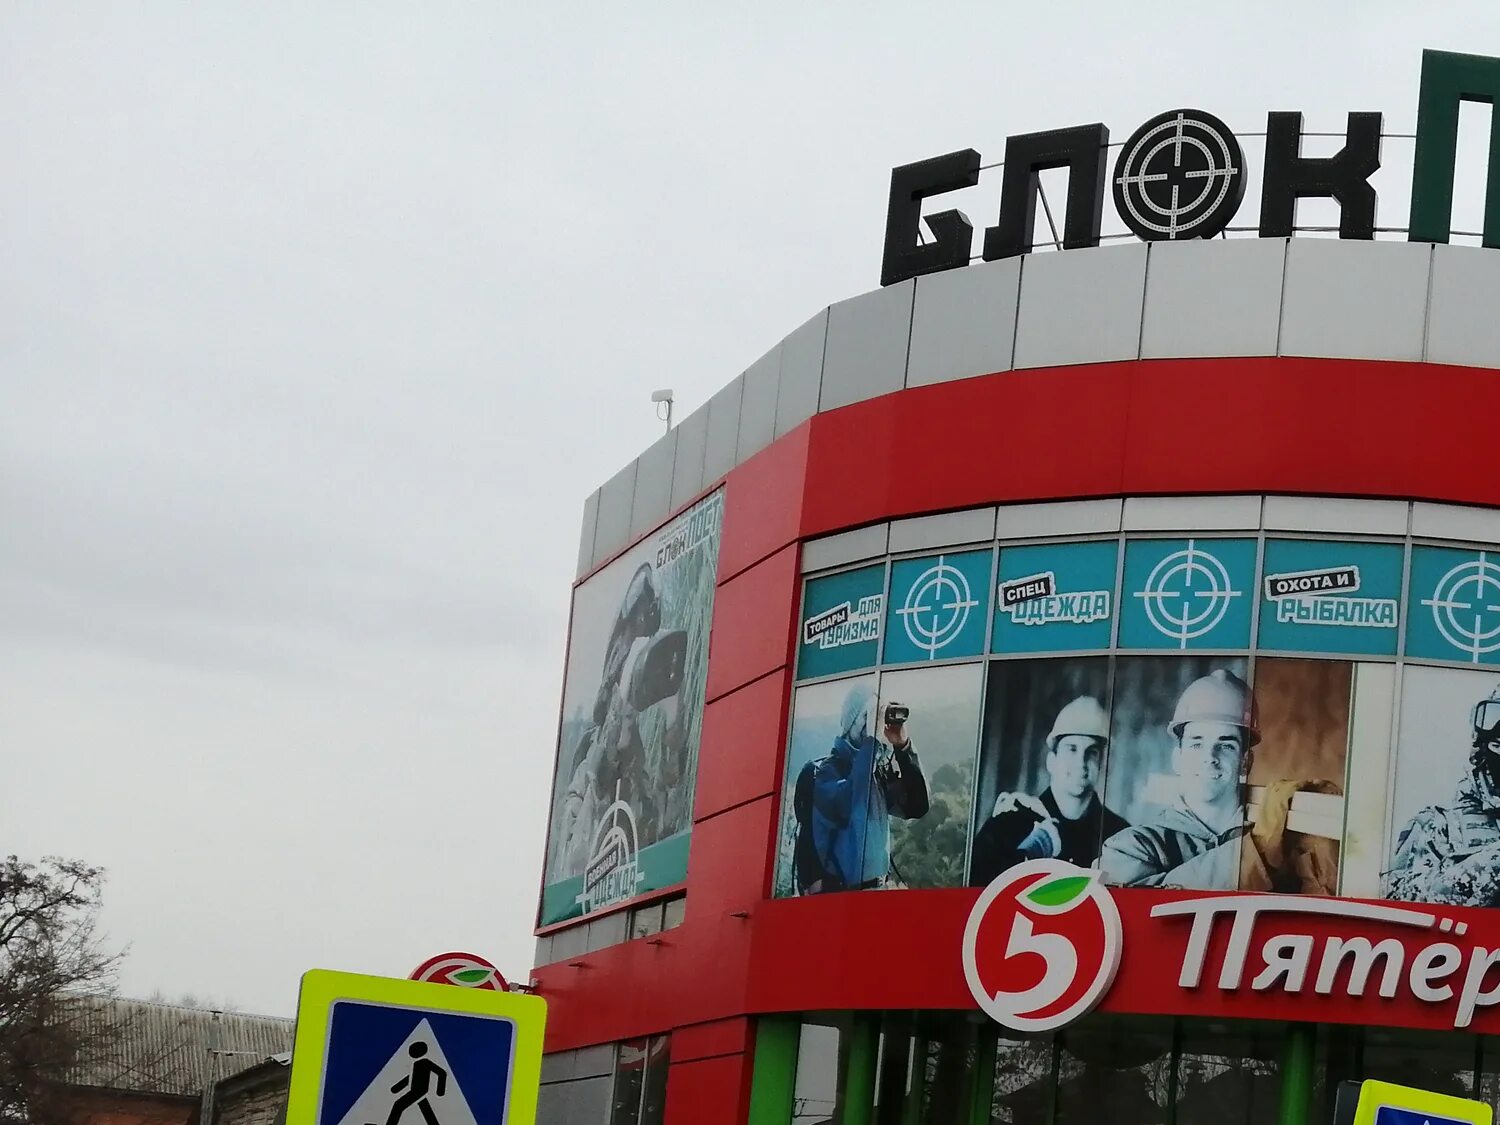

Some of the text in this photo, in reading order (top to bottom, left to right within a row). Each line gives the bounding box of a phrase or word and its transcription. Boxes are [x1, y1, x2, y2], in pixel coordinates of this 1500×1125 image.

[1006, 581, 1046, 601] СПЕЦ
[1276, 573, 1349, 593] ОХОТА И
[809, 597, 881, 635] ТОВАРЫ ДЛЯ
[1015, 594, 1106, 620] ОДЕЖДА
[1281, 598, 1394, 624] РЫБАЛКА
[821, 617, 879, 646] ТУРИЗМА
